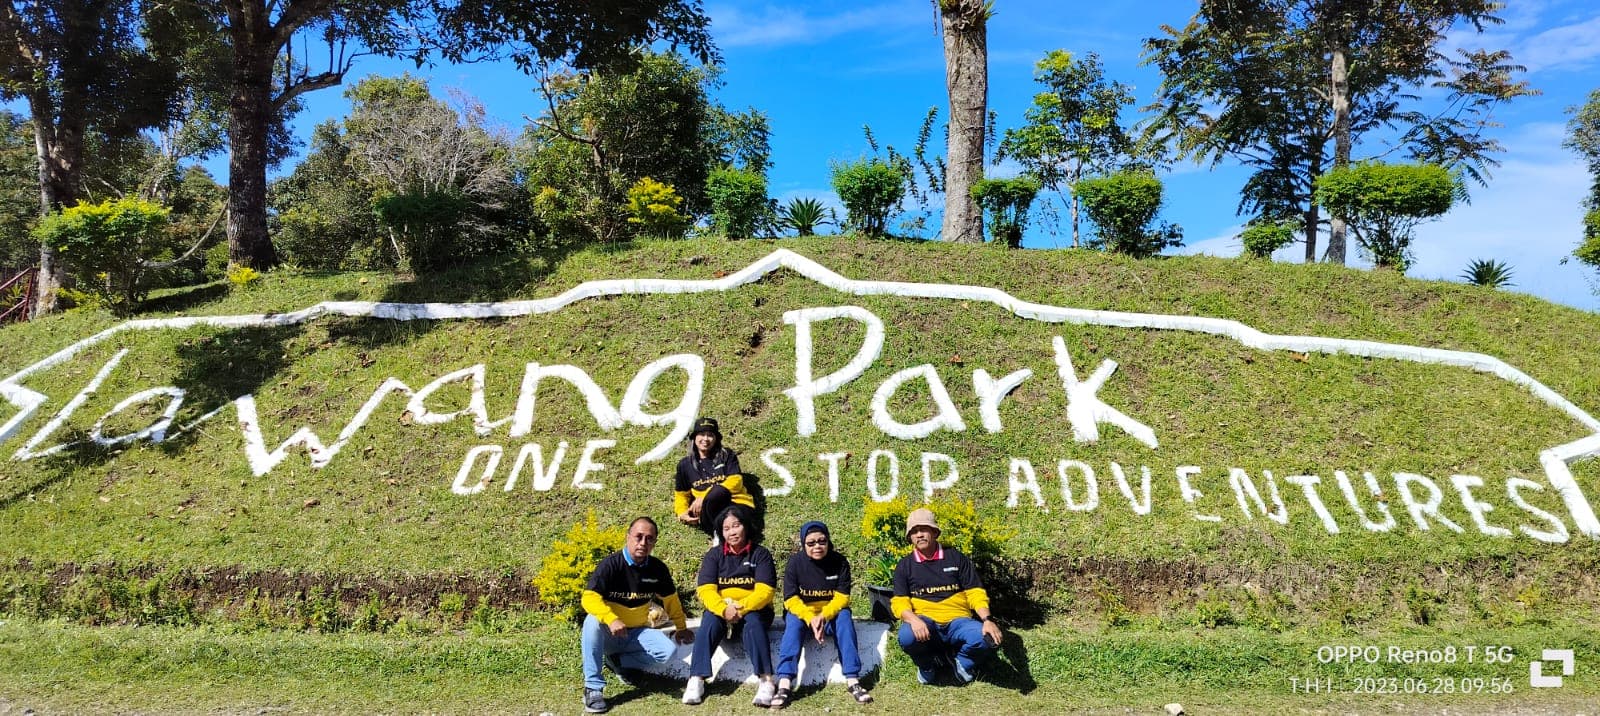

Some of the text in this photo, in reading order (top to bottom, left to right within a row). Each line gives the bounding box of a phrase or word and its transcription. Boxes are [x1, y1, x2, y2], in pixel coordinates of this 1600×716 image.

[782, 305, 1159, 449] Park
[451, 438, 1570, 544] ONE STOP ADVENTURES
